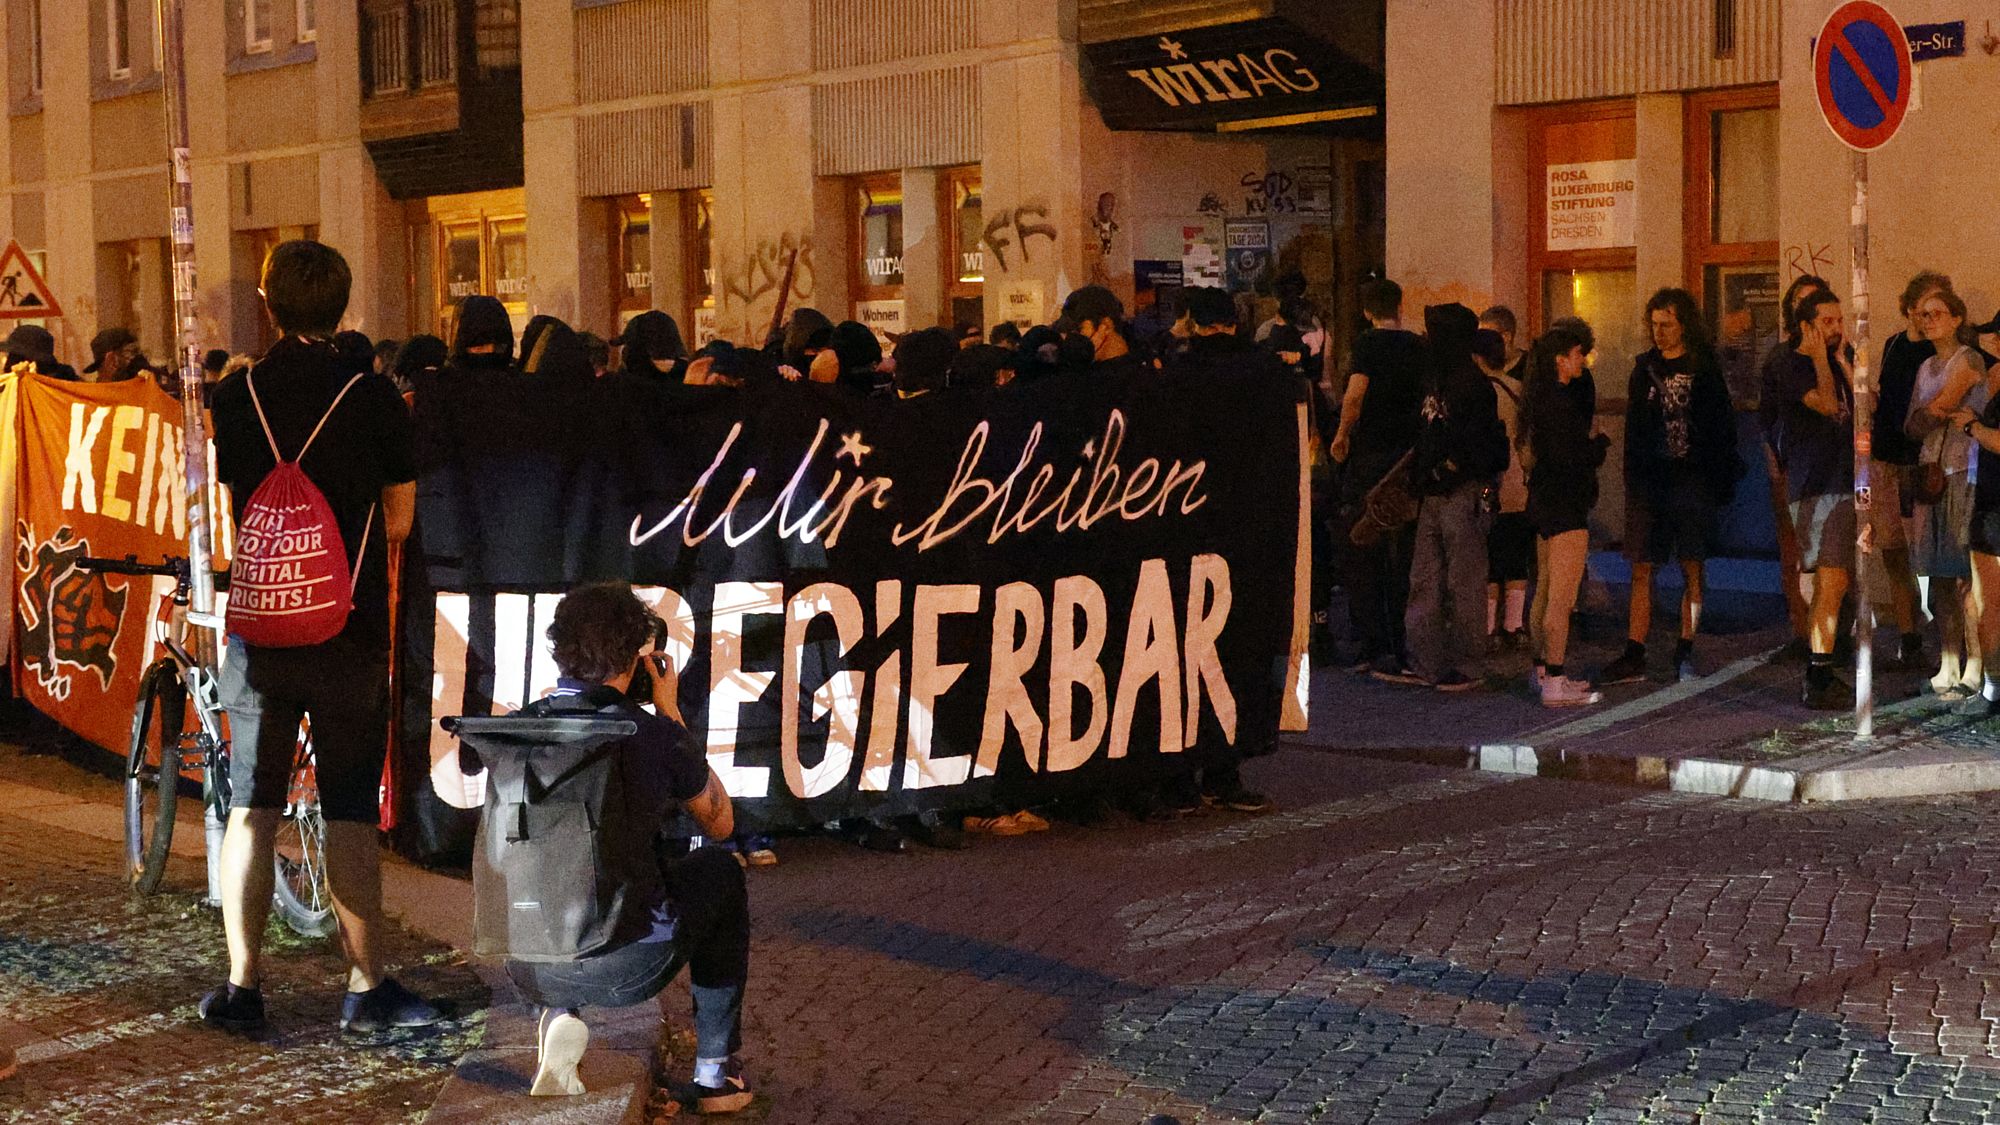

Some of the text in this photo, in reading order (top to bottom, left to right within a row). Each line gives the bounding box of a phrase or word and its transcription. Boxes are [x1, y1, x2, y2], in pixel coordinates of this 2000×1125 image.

[1909, 32, 1957, 53] er-Str.
[1127, 36, 1320, 107] wirAG
[1551, 170, 1589, 182] ROSA
[1551, 180, 1635, 197] LUXEMBURG
[1551, 196, 1617, 211] STIFTUNG
[1551, 211, 1606, 226] SACHSEN
[1551, 225, 1602, 240] DRESDEN
[1784, 240, 1835, 281] RK
[862, 309, 899, 321] Wohnen
[629, 408, 1207, 552] Wir bleiben
[232, 561, 306, 584] DIGITAL
[231, 585, 313, 610] RIGHTS!
